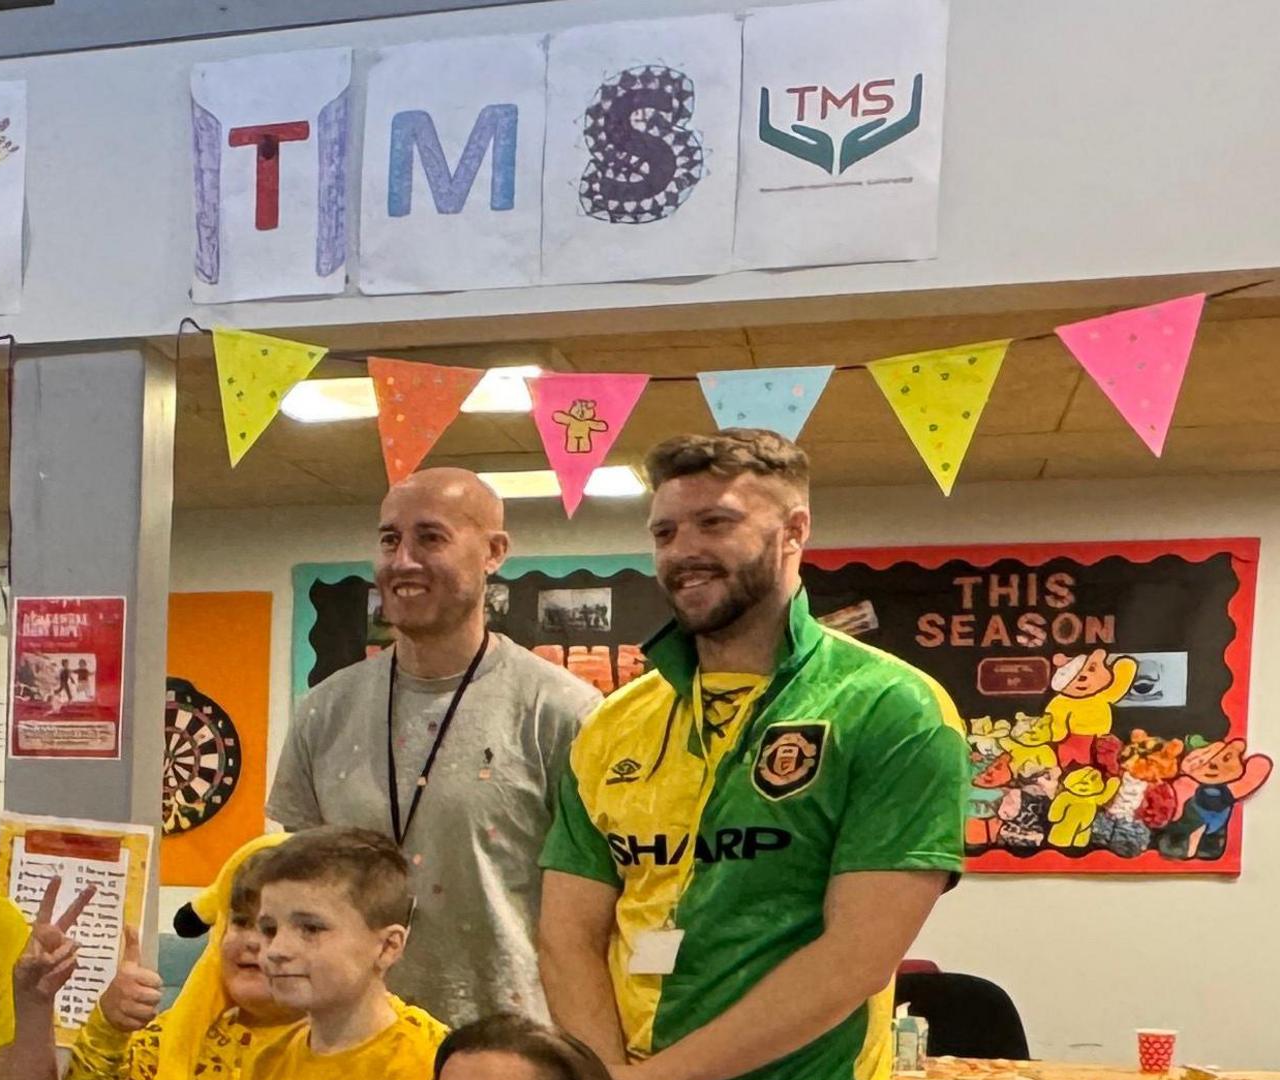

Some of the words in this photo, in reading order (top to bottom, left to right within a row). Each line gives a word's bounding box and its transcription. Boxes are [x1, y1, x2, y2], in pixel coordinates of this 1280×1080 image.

[786, 78, 896, 122] TMS
[953, 572, 1076, 609] THIS
[915, 612, 1117, 648] SEASON
[607, 826, 793, 867] SHARP
